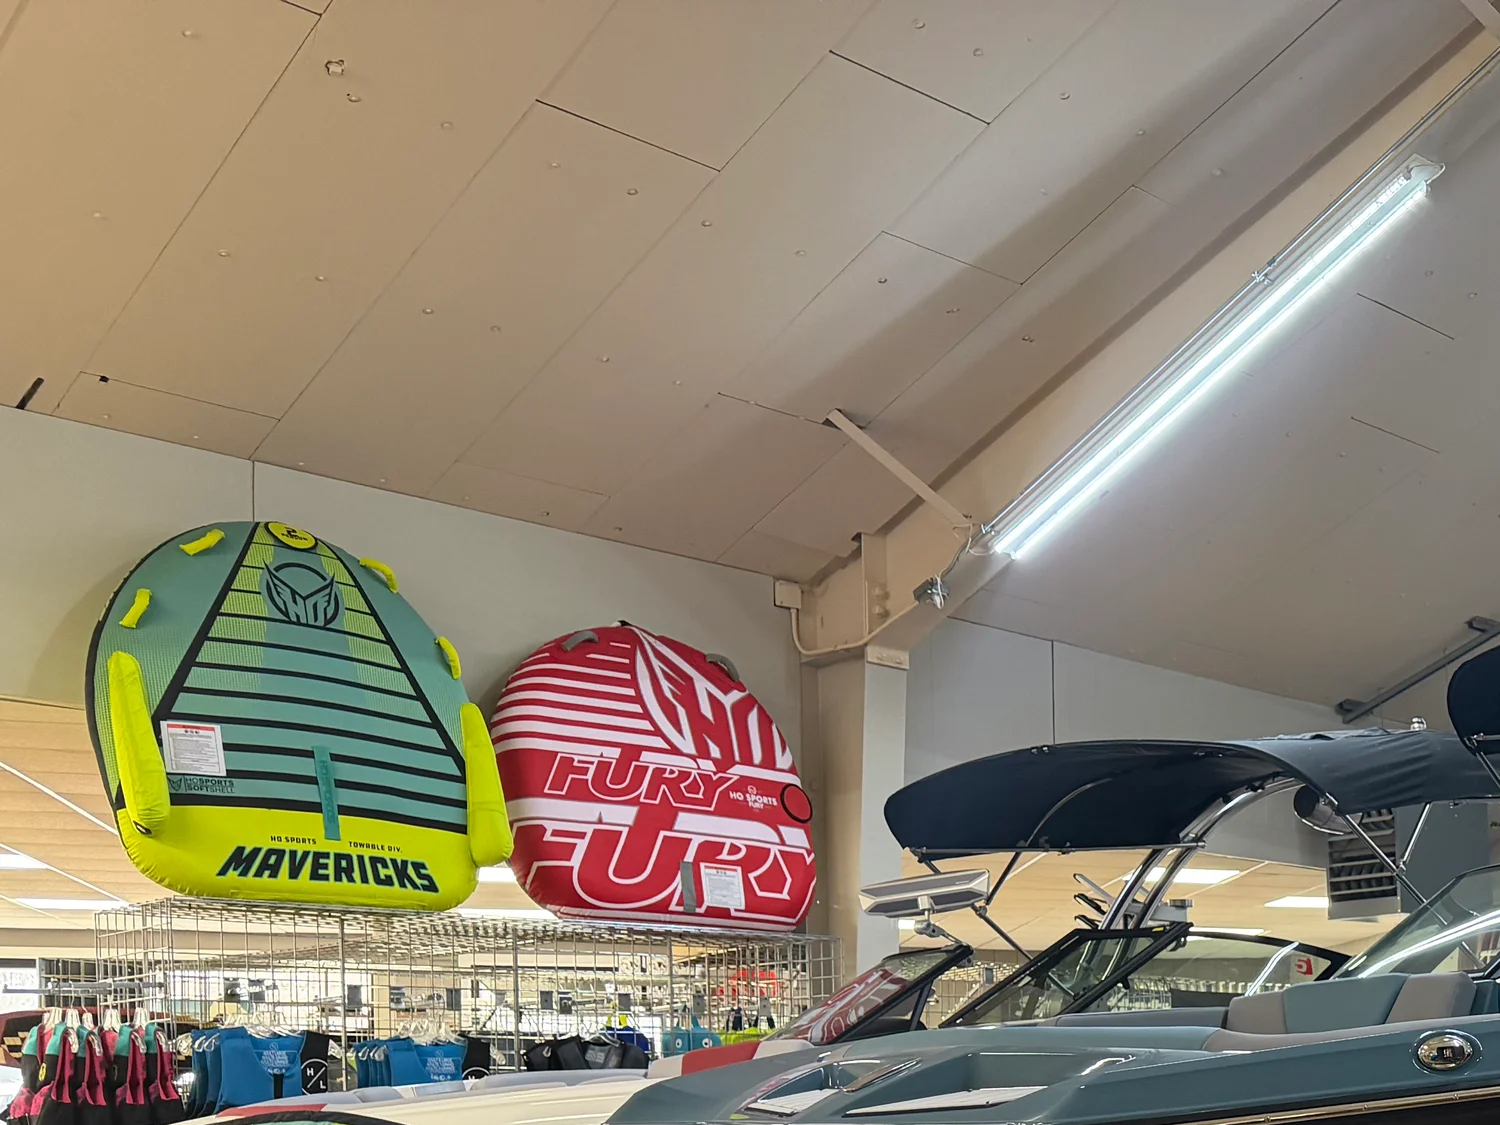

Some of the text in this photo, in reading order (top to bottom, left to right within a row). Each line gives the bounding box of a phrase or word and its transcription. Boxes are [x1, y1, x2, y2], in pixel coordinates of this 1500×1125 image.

[543, 749, 740, 812] FURY
[729, 791, 778, 807] HO SPORTS
[270, 835, 317, 845] HO SPORTS
[348, 841, 403, 853] TOWABLE DIV.
[215, 845, 441, 894] MAVERICKS
